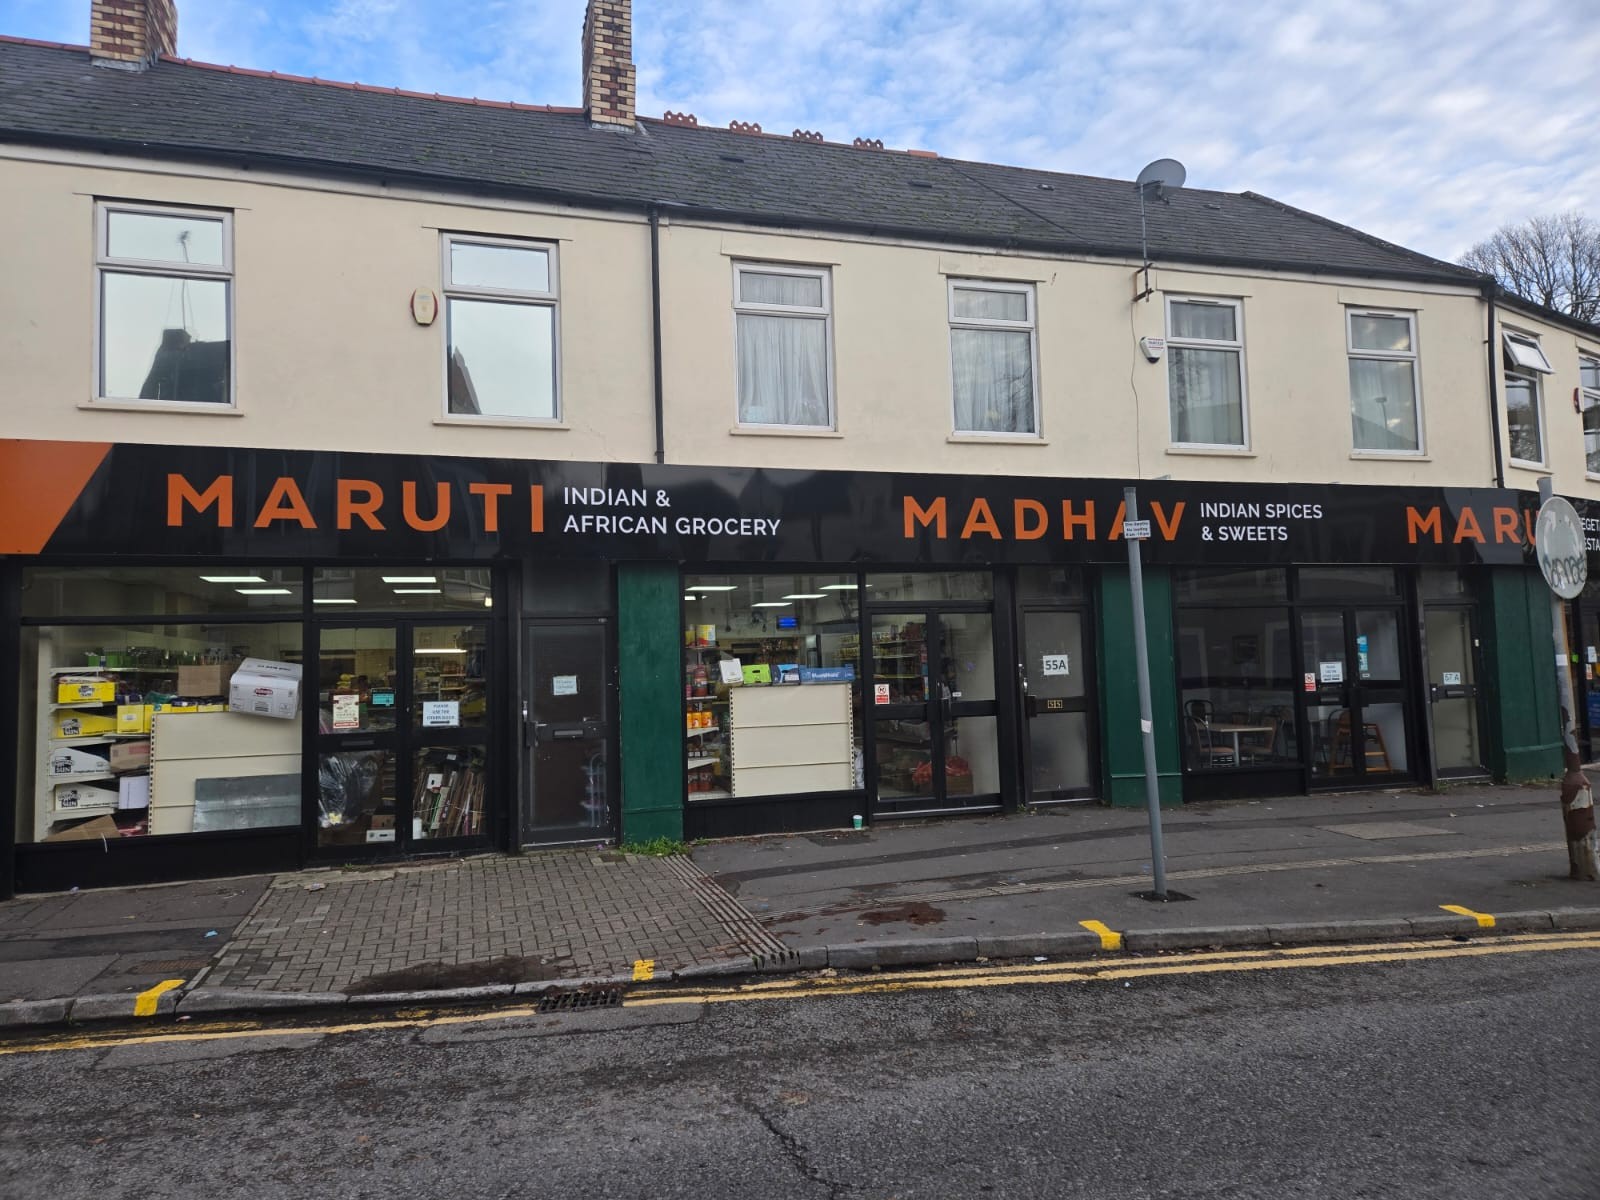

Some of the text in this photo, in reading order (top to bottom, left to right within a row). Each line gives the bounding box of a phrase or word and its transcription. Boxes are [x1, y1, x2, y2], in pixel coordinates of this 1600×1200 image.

[166, 473, 545, 533] MARUTI
[563, 486, 671, 508] INDIAN &
[1200, 502, 1323, 520] INDIAN SPICES
[563, 514, 781, 536] AFRICAN GROCERY
[1201, 525, 1289, 542] & SWEETS
[1580, 518, 1600, 532] EGET
[1045, 659, 1067, 671] 55A
